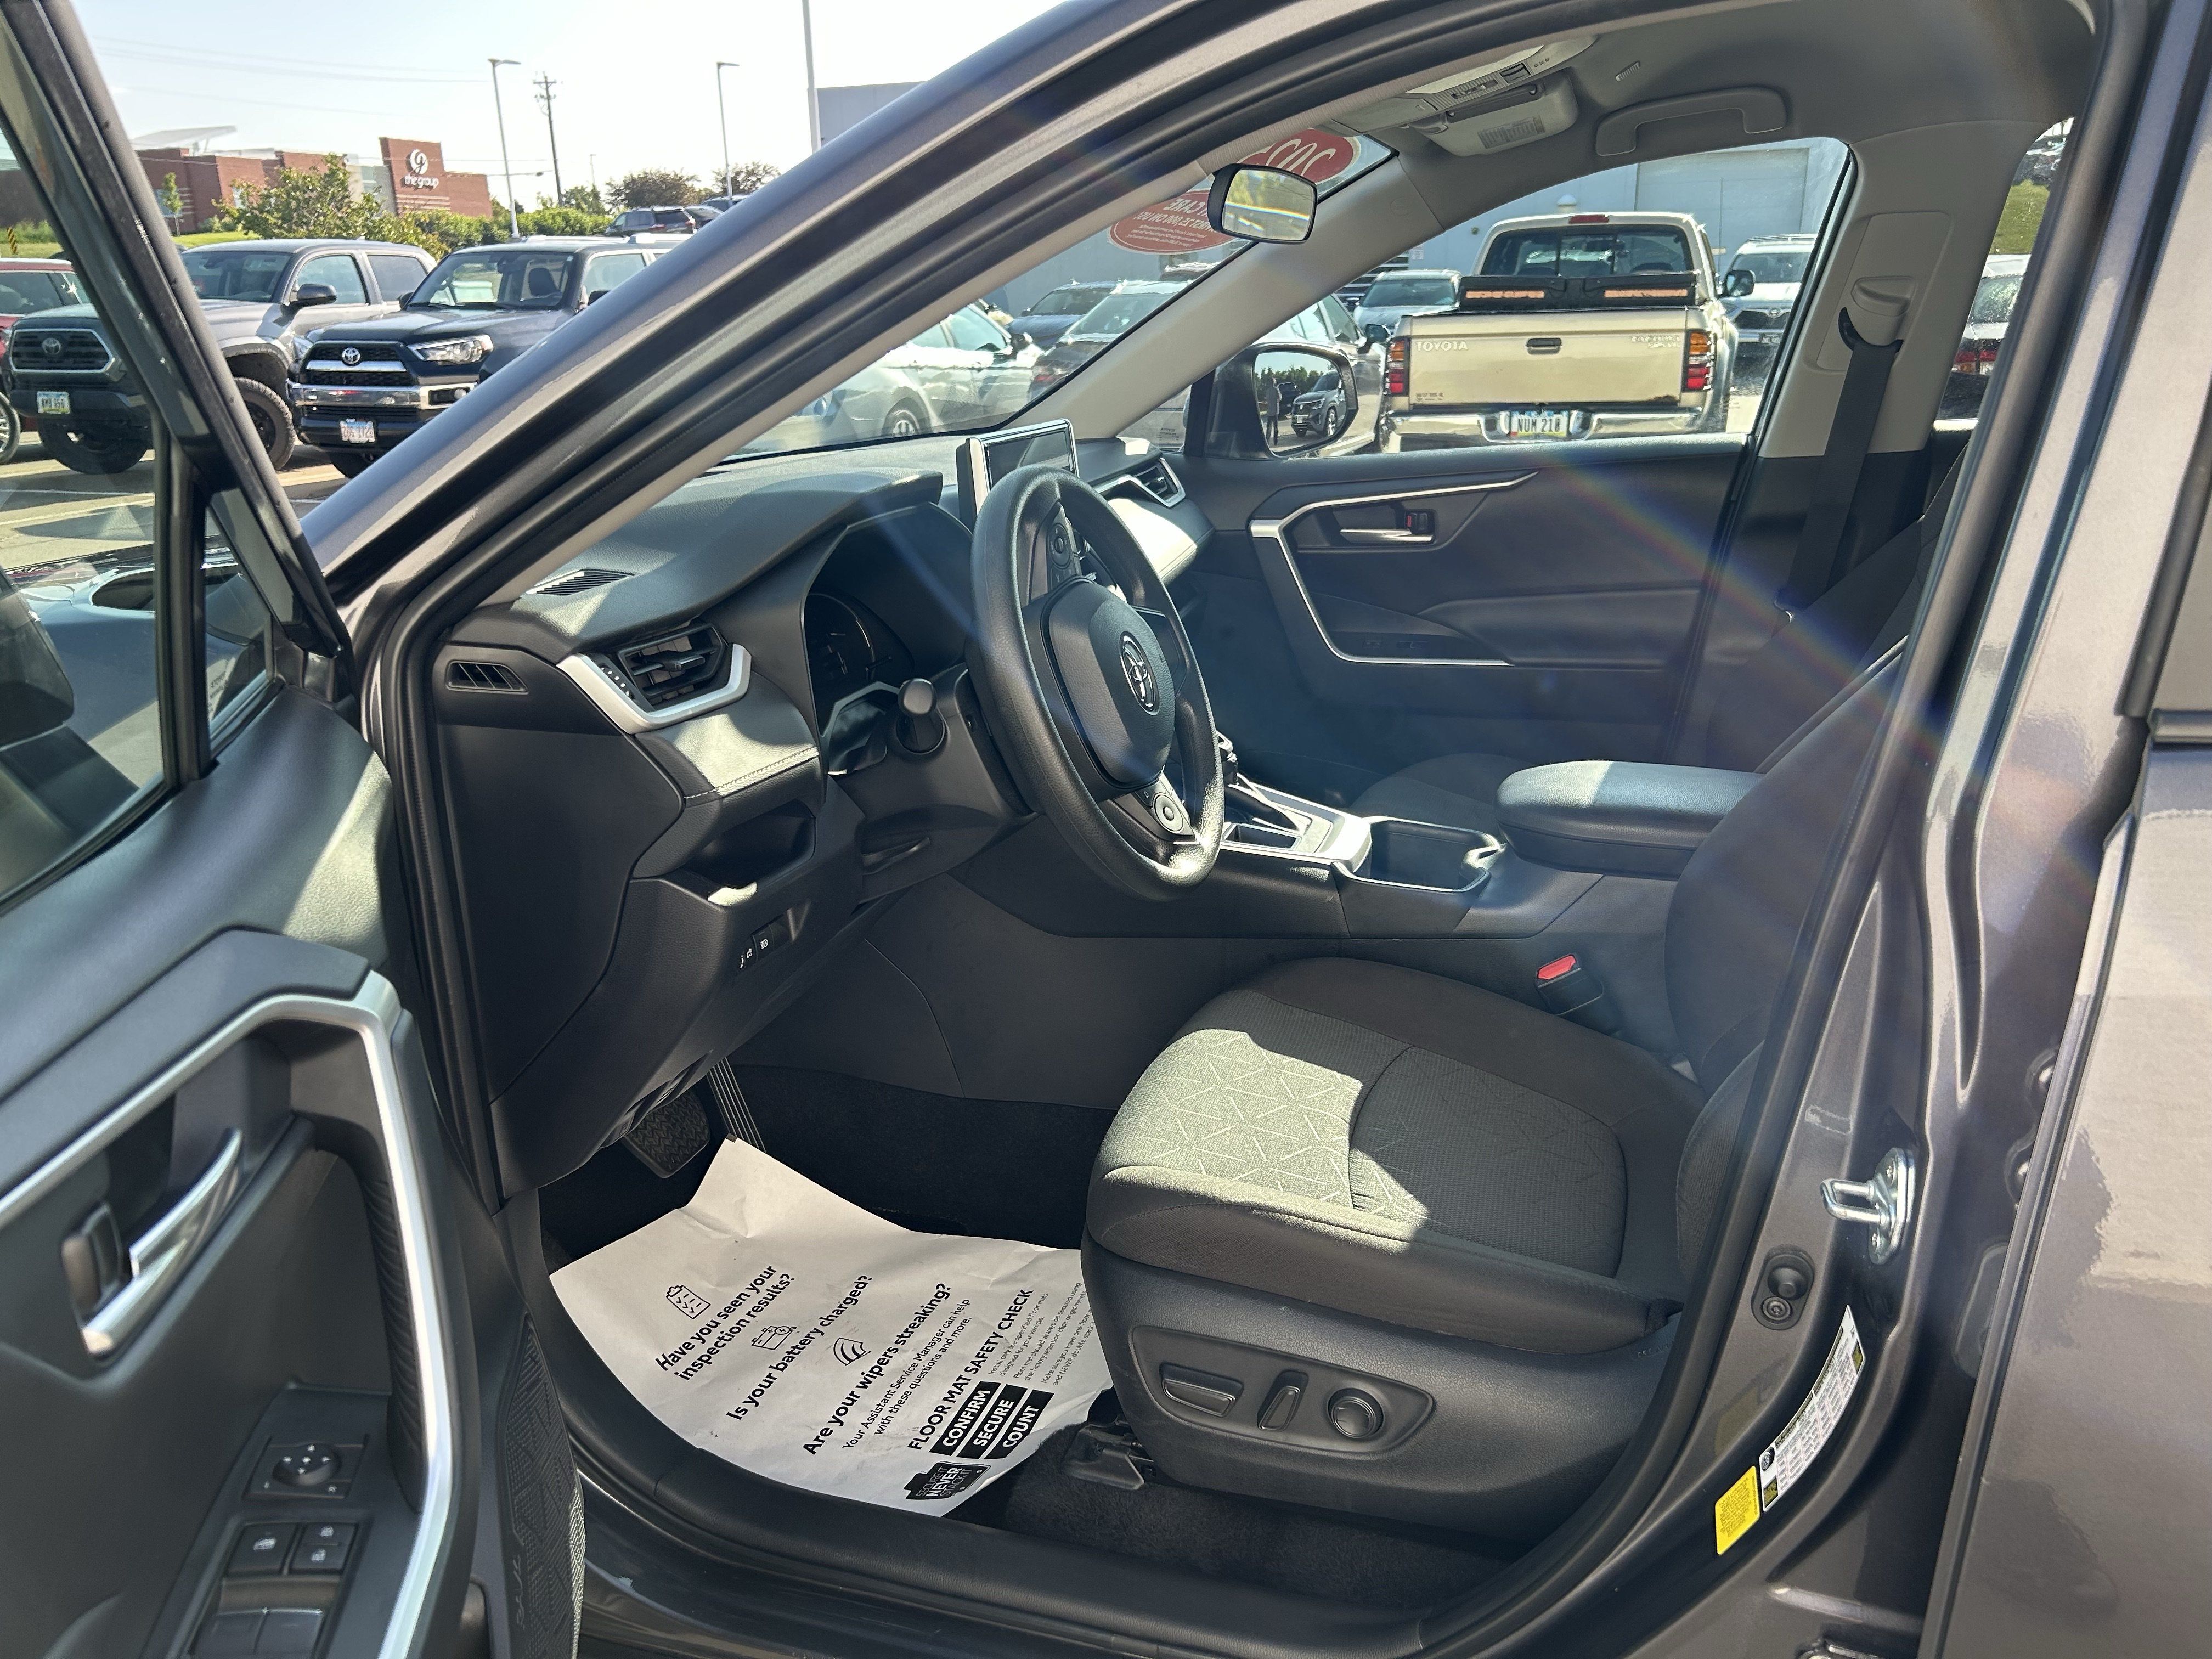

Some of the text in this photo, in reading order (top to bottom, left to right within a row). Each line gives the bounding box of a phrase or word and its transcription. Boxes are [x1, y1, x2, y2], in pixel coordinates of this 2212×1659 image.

[404, 173, 439, 189] the group
[1416, 341, 1468, 352] TOYOTA
[656, 1266, 777, 1371] Have you seen your
[674, 1273, 794, 1380] inspection results?
[726, 1275, 872, 1420] Is your battery charged?
[989, 1357, 1003, 1375] Install
[1008, 1341, 1017, 1349] the
[1015, 1318, 1032, 1341] specified
[1028, 1305, 1039, 1318] floor
[1013, 1367, 1025, 1378] Floor
[1024, 1357, 1034, 1367] mat
[1042, 1320, 1056, 1340] always
[1058, 1297, 1073, 1315] secured
[803, 1283, 951, 1455] Are your wipers streaking?
[842, 1299, 969, 1448] Your Assistant Service Manager can help
[874, 1318, 972, 1435] with these questions and more.
[907, 1289, 1034, 1449] FLOOR MAT SAFETY CHECK
[1000, 1355, 1019, 1376] designed
[1023, 1335, 1033, 1347] your
[1025, 1371, 1034, 1380] the
[1030, 1354, 1047, 1372] factory
[1044, 1333, 1060, 1355] retention
[1041, 1369, 1054, 1384] Make
[1052, 1359, 1062, 1369] sure
[1060, 1349, 1068, 1359] you
[1066, 1336, 1076, 1349] have
[1074, 1325, 1083, 1336] one
[1053, 1375, 1063, 1385] and
[1059, 1358, 1073, 1375] NEVER
[1072, 1339, 1085, 1357] double
[1084, 1326, 1094, 1339] stack
[943, 1390, 990, 1446] CONFIRM
[973, 1400, 1014, 1446] SECURE
[1002, 1406, 1039, 1447] COUNT
[926, 1468, 962, 1496] NEVER
